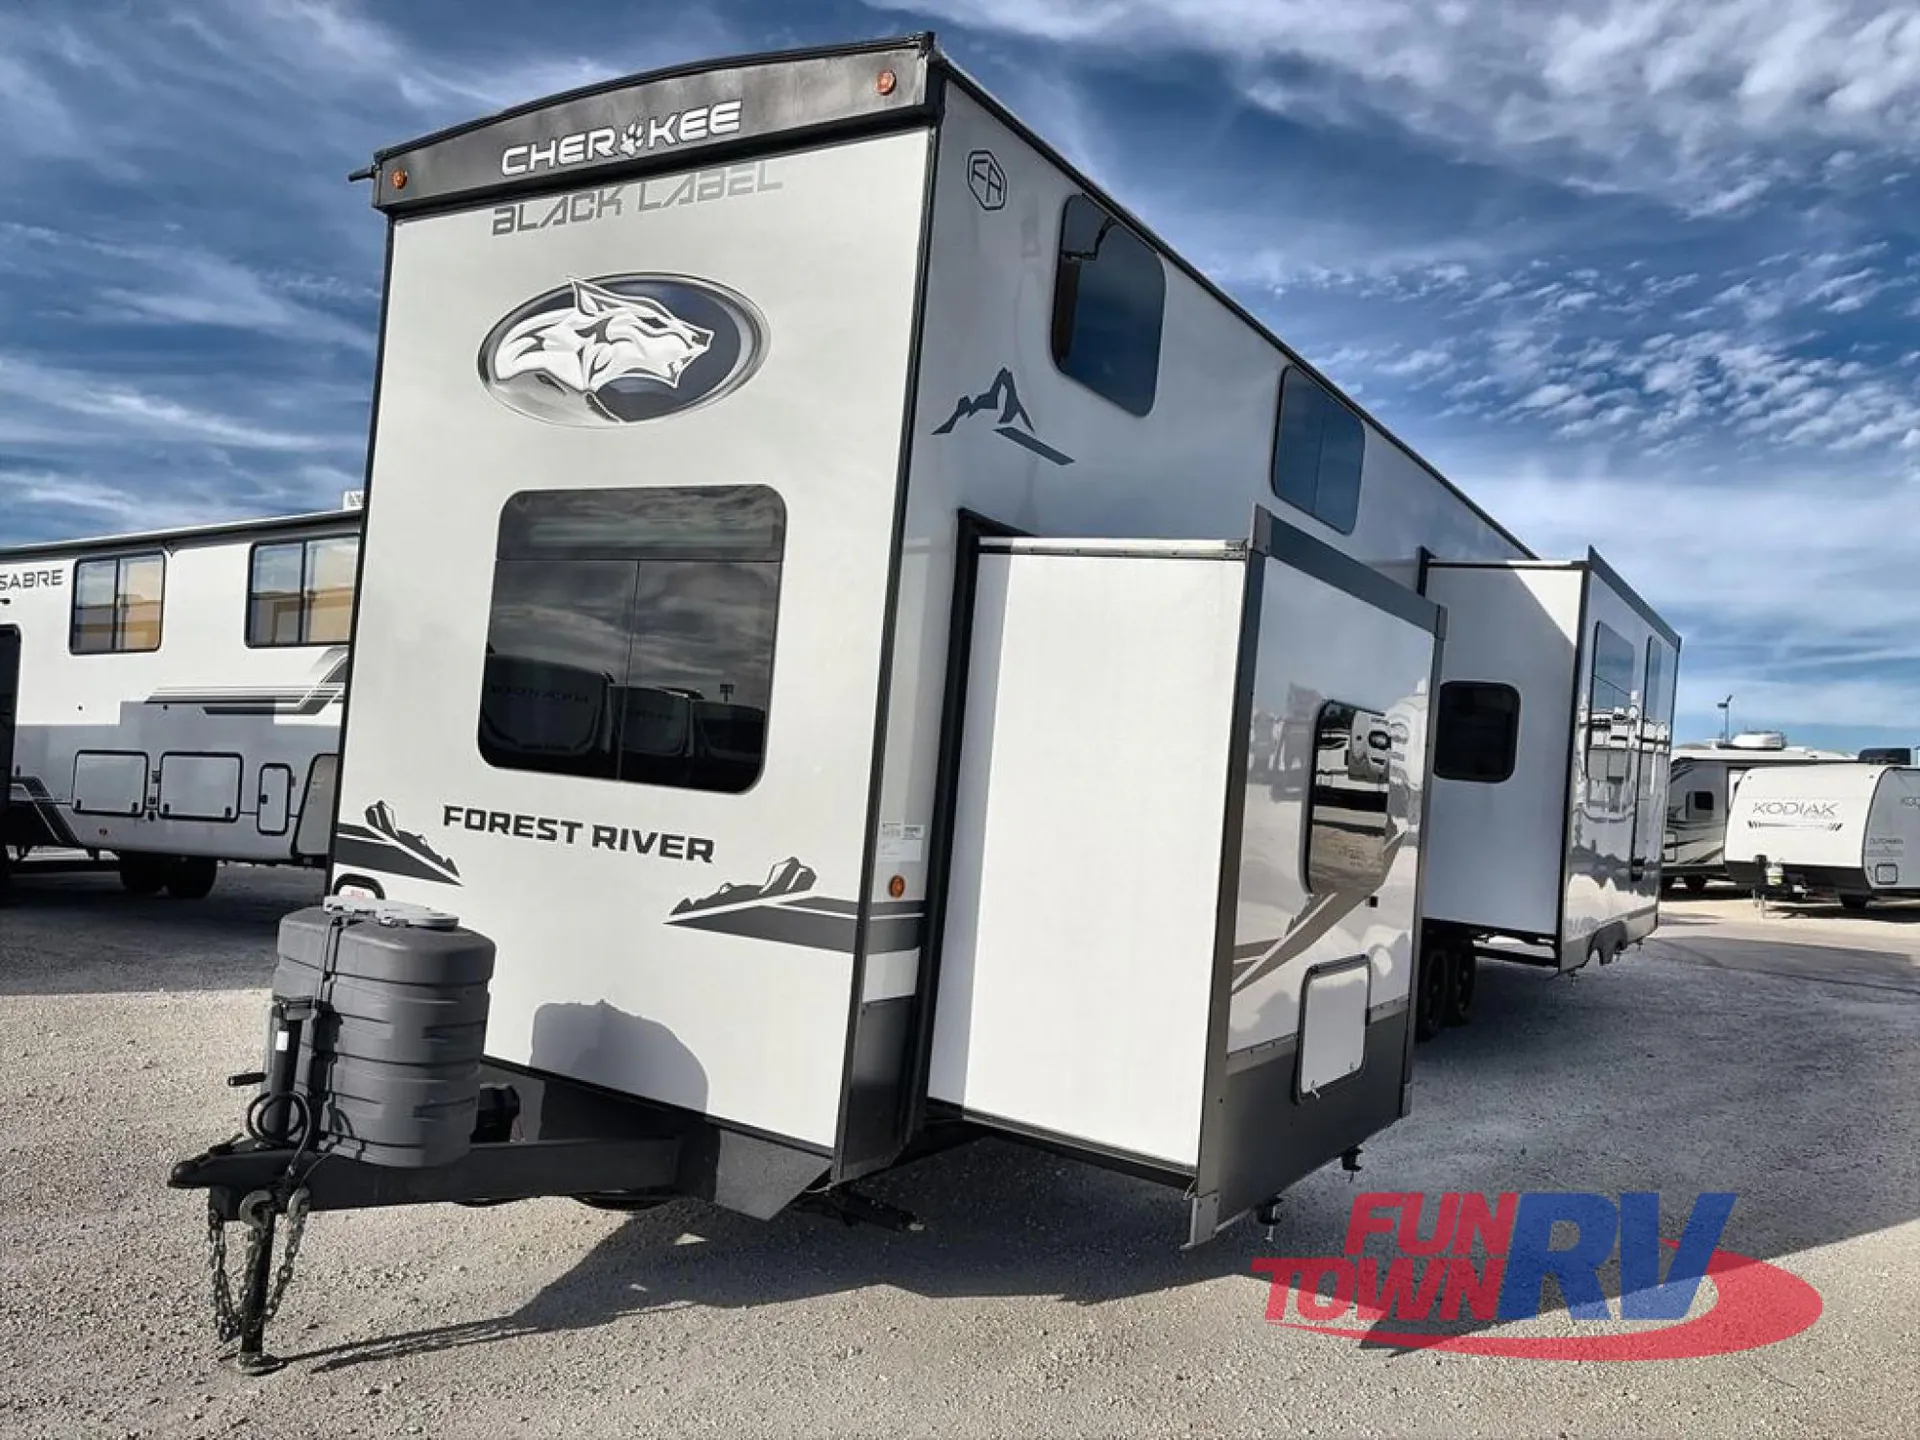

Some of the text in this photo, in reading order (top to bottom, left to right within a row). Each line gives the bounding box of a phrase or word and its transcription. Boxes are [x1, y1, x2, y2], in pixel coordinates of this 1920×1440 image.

[491, 160, 784, 236] BLACK LABEL
[0, 568, 64, 592] SABRE
[1752, 801, 1839, 816] KODIAK
[442, 804, 716, 864] FOREST RIVER
